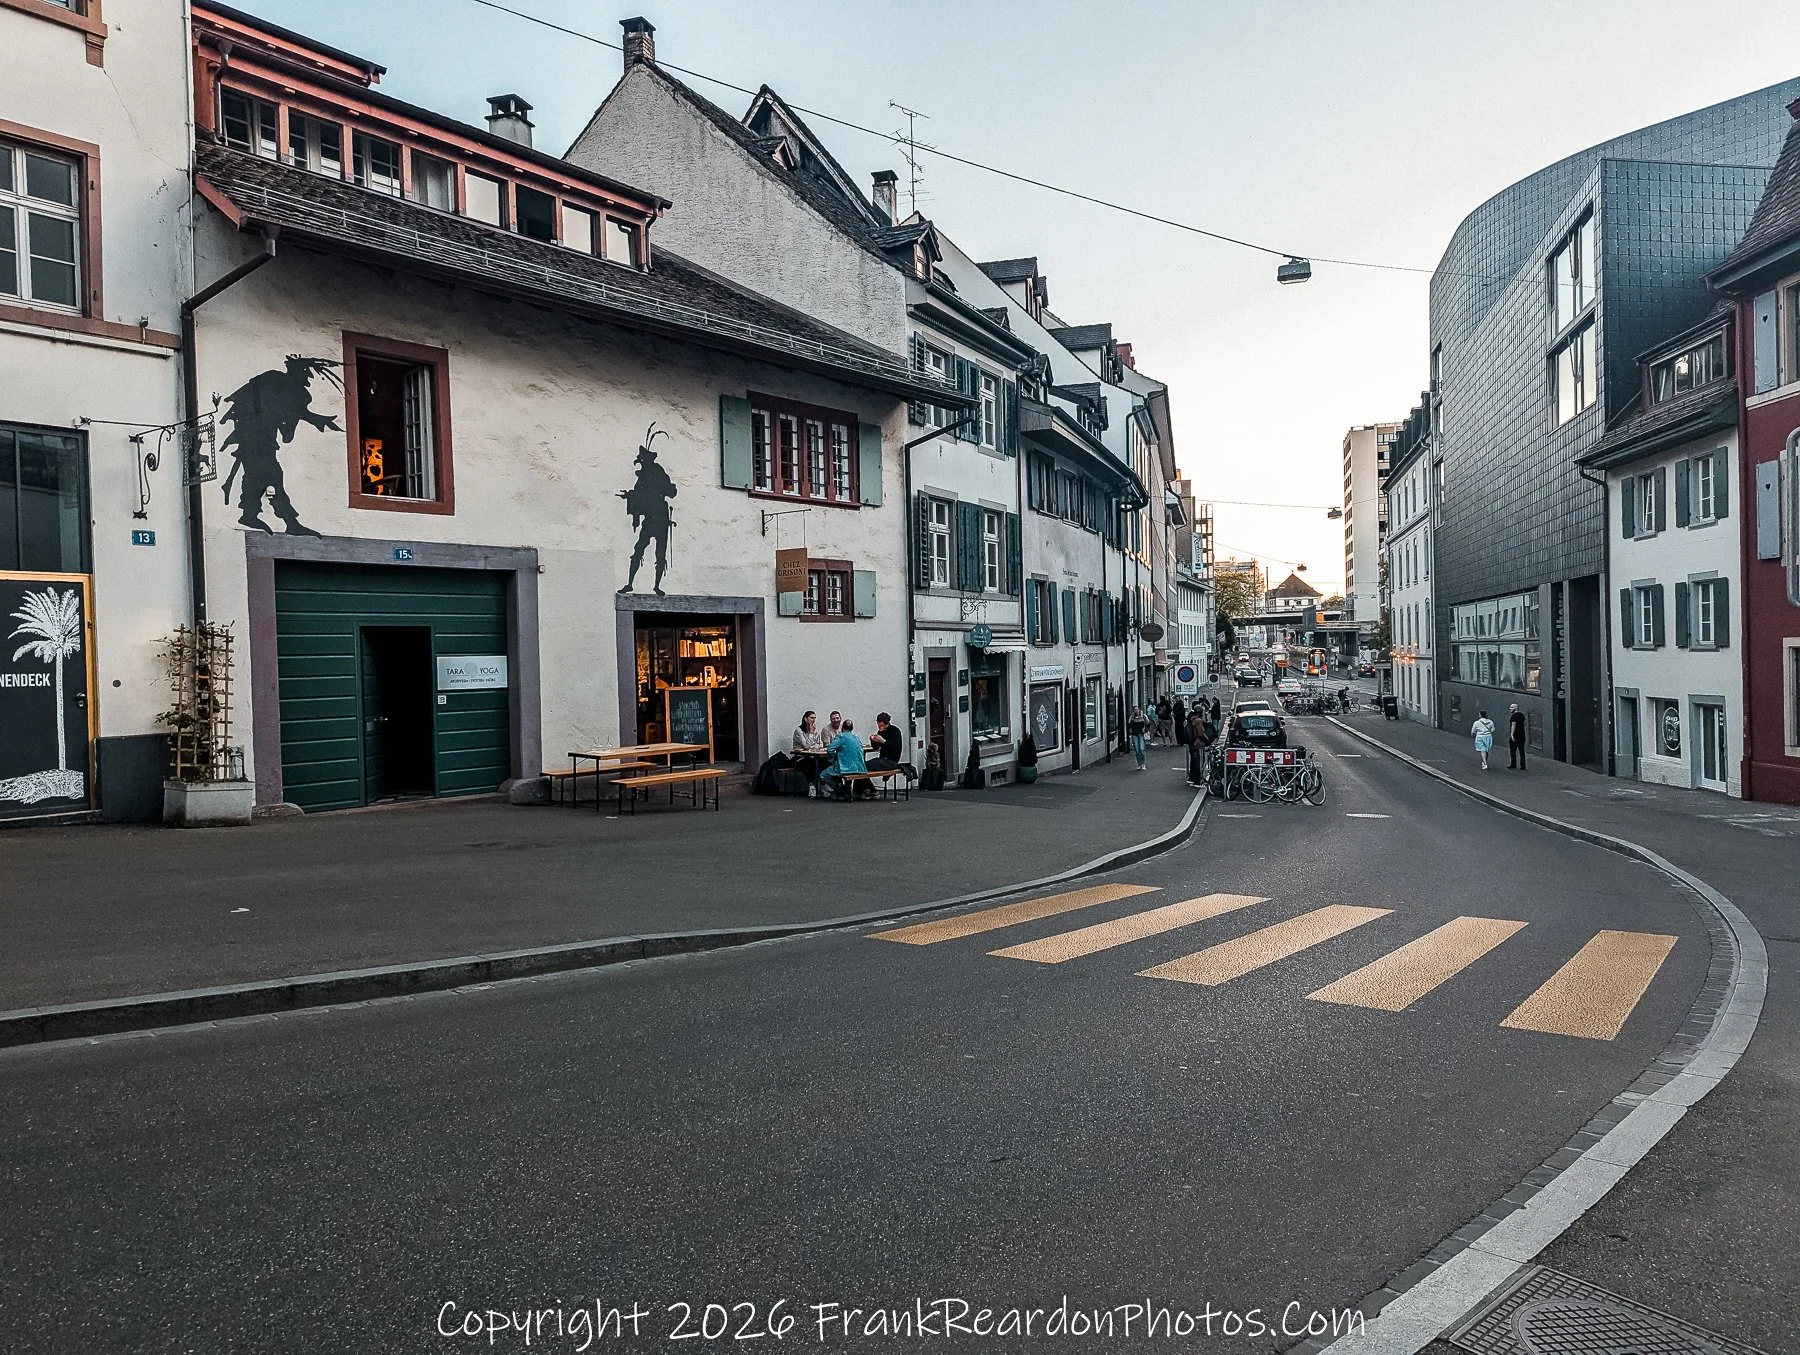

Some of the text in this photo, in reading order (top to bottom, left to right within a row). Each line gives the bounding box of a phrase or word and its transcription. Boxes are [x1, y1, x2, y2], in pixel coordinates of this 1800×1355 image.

[138, 532, 150, 543] 13
[783, 561, 801, 569] CHEZ
[778, 568, 806, 577] GRISONI
